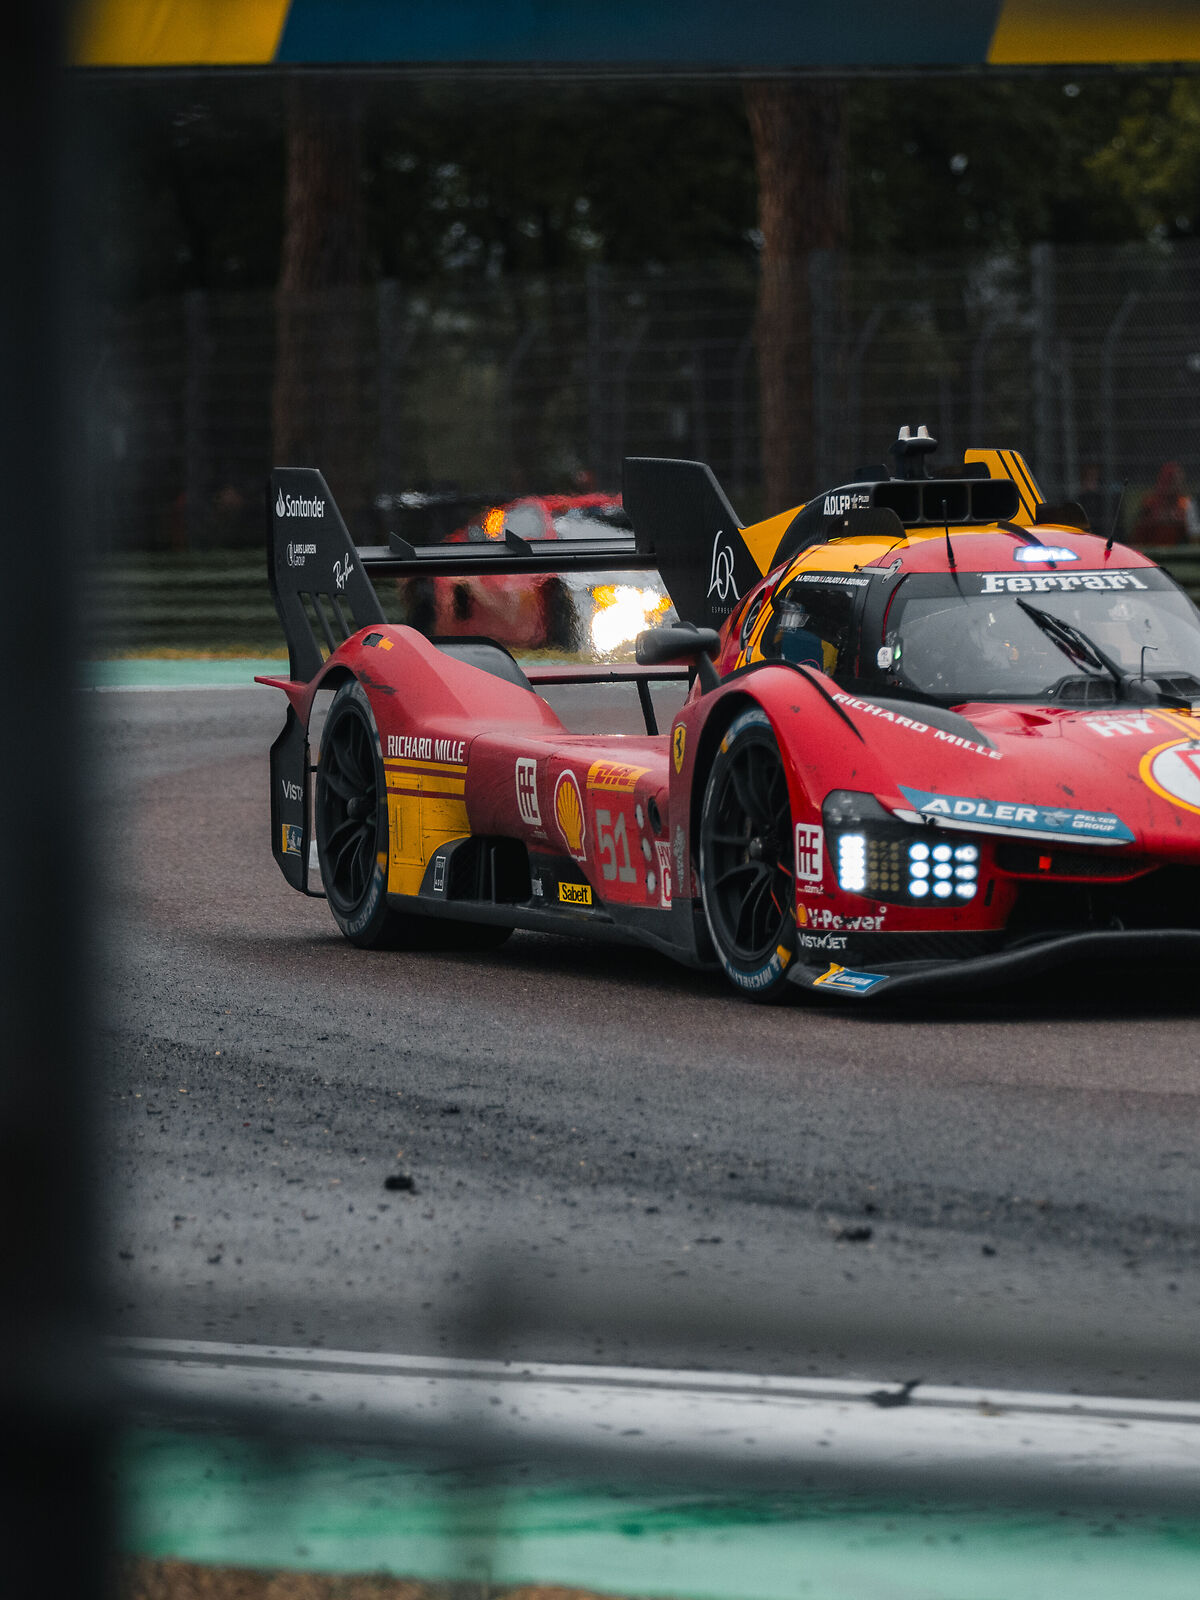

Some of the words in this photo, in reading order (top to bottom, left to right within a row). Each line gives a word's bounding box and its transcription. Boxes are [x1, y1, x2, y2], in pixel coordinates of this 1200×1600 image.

[285, 494, 325, 518] Santander
[824, 495, 851, 515] ADLER
[981, 571, 1148, 594] Ferrari
[832, 693, 929, 733] RICHARD
[934, 729, 1003, 760] MILLE
[387, 735, 432, 759] RICHARD
[434, 739, 466, 763] MILLE
[921, 799, 1038, 823] ADLER
[1071, 821, 1116, 832] GROUP
[595, 809, 636, 883] 51
[562, 884, 588, 903] Sabelt
